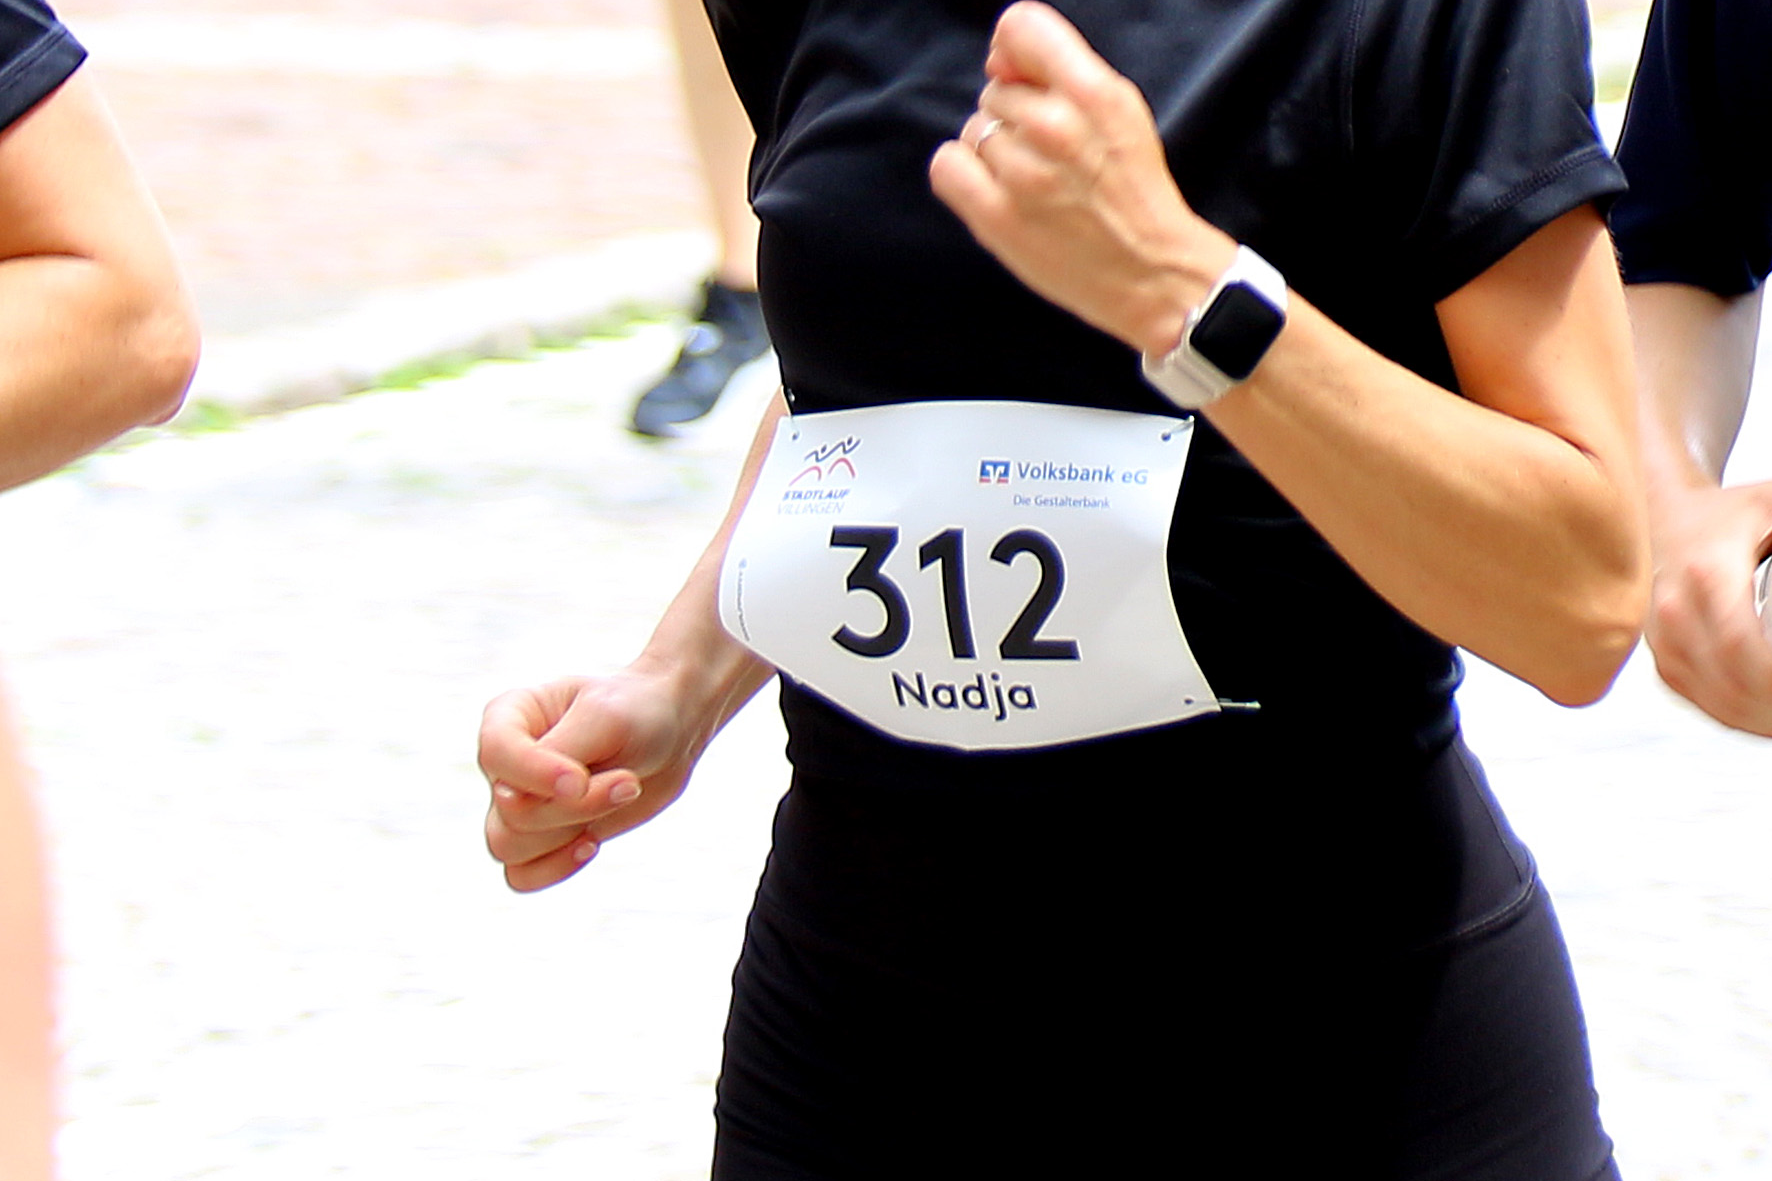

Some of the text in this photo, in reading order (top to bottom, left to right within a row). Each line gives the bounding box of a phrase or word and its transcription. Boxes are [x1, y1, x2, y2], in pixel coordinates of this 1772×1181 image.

[1017, 460, 1149, 485] Volksbank eG
[782, 488, 851, 501] STADTLAUF
[1013, 493, 1111, 509] Die Gestalterbank
[829, 525, 1081, 661] 312
[890, 670, 1038, 721] Nadja
